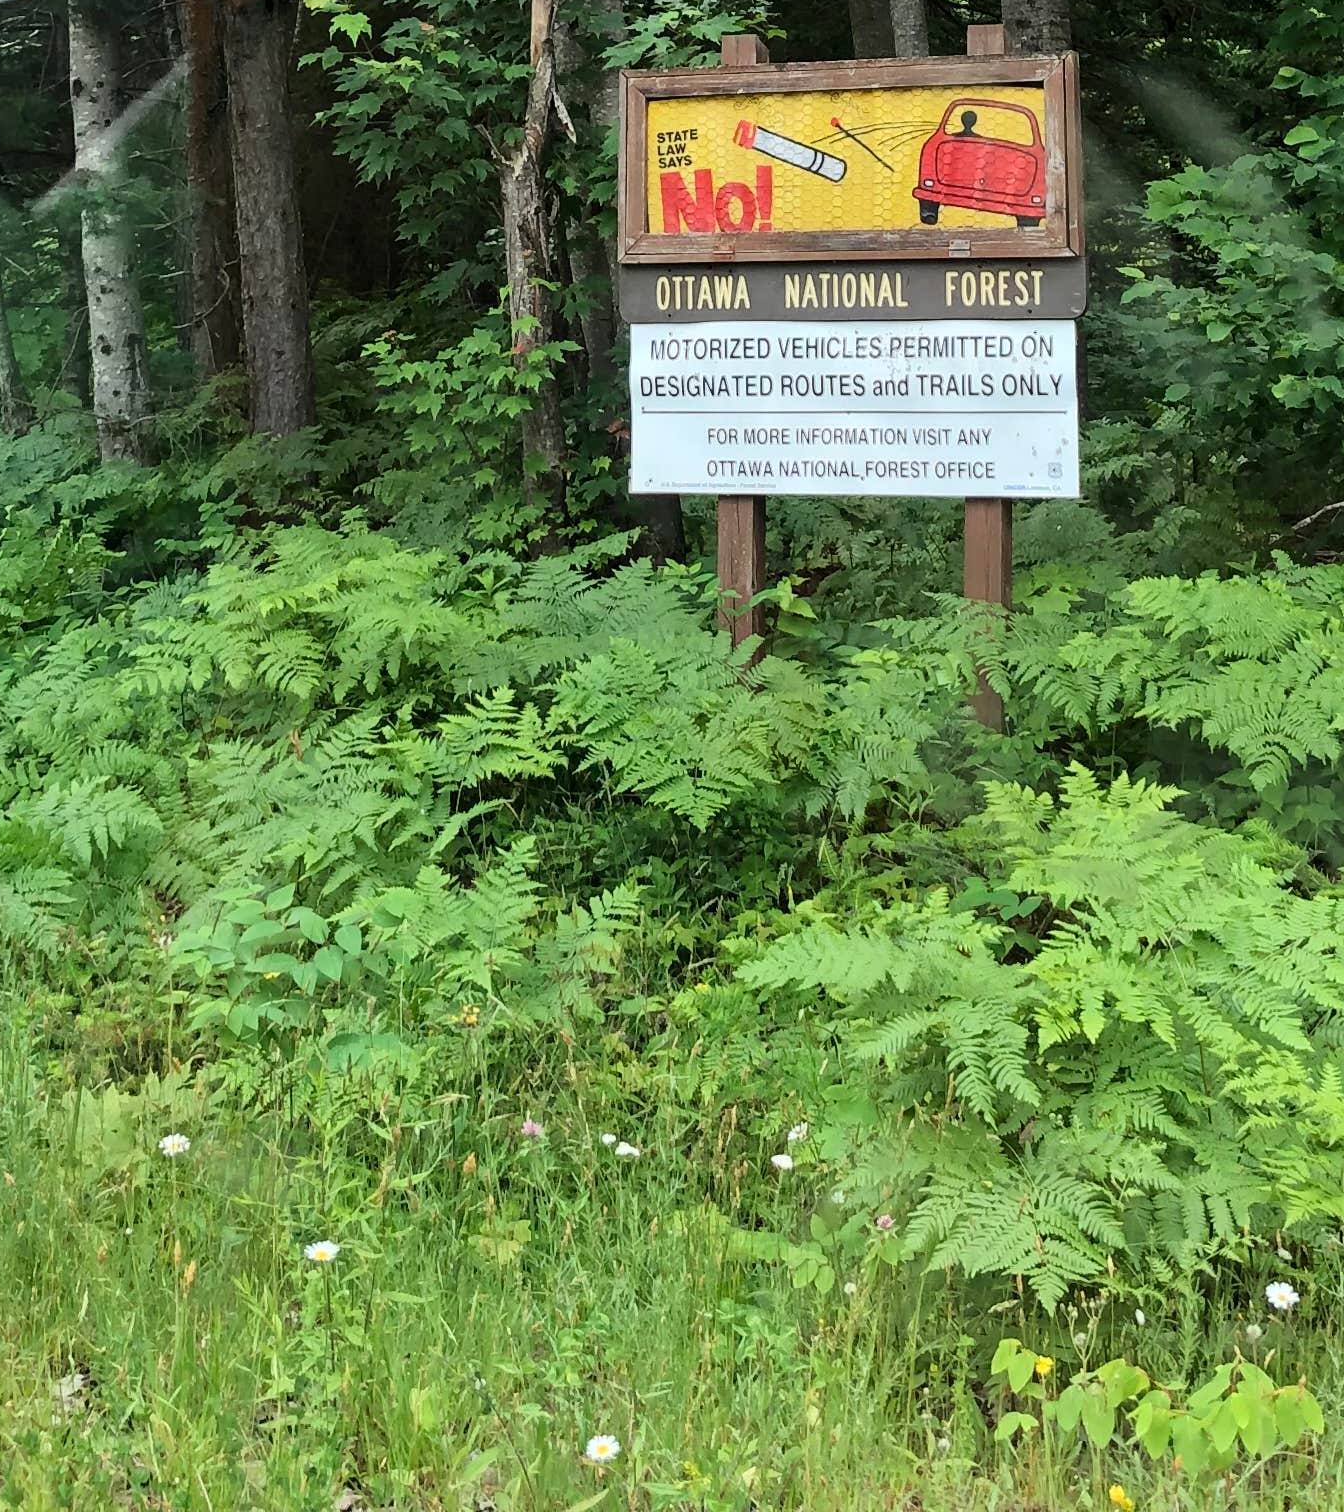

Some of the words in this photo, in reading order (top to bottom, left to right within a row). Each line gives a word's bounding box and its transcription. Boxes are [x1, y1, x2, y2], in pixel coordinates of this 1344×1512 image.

[657, 129, 698, 143] STATE
[657, 143, 687, 156] LAW
[658, 155, 692, 169] SAYS
[656, 274, 751, 311] OTTAWA
[783, 272, 909, 308] NATIONAL
[944, 270, 1044, 306] FOREST
[650, 337, 771, 360] MOTORIZED
[778, 336, 882, 359] VEHICLES
[889, 335, 1013, 358] PERMITTED
[1021, 335, 1053, 357] ON
[640, 374, 773, 397] DESIGNATED
[781, 374, 866, 397] ROUTES
[872, 375, 909, 397] and
[916, 374, 994, 397] TRAILS
[1002, 373, 1063, 397] ONLY
[707, 428, 739, 445] FOR
[743, 428, 791, 445] MORE
[795, 428, 907, 445] INFORMATION
[912, 428, 952, 445] VISIT
[957, 428, 992, 445] ANY
[707, 460, 774, 478] OTTAWA
[779, 460, 858, 478] NATIONAL
[864, 461, 929, 478] FOREST
[934, 461, 996, 478] OFFICE
